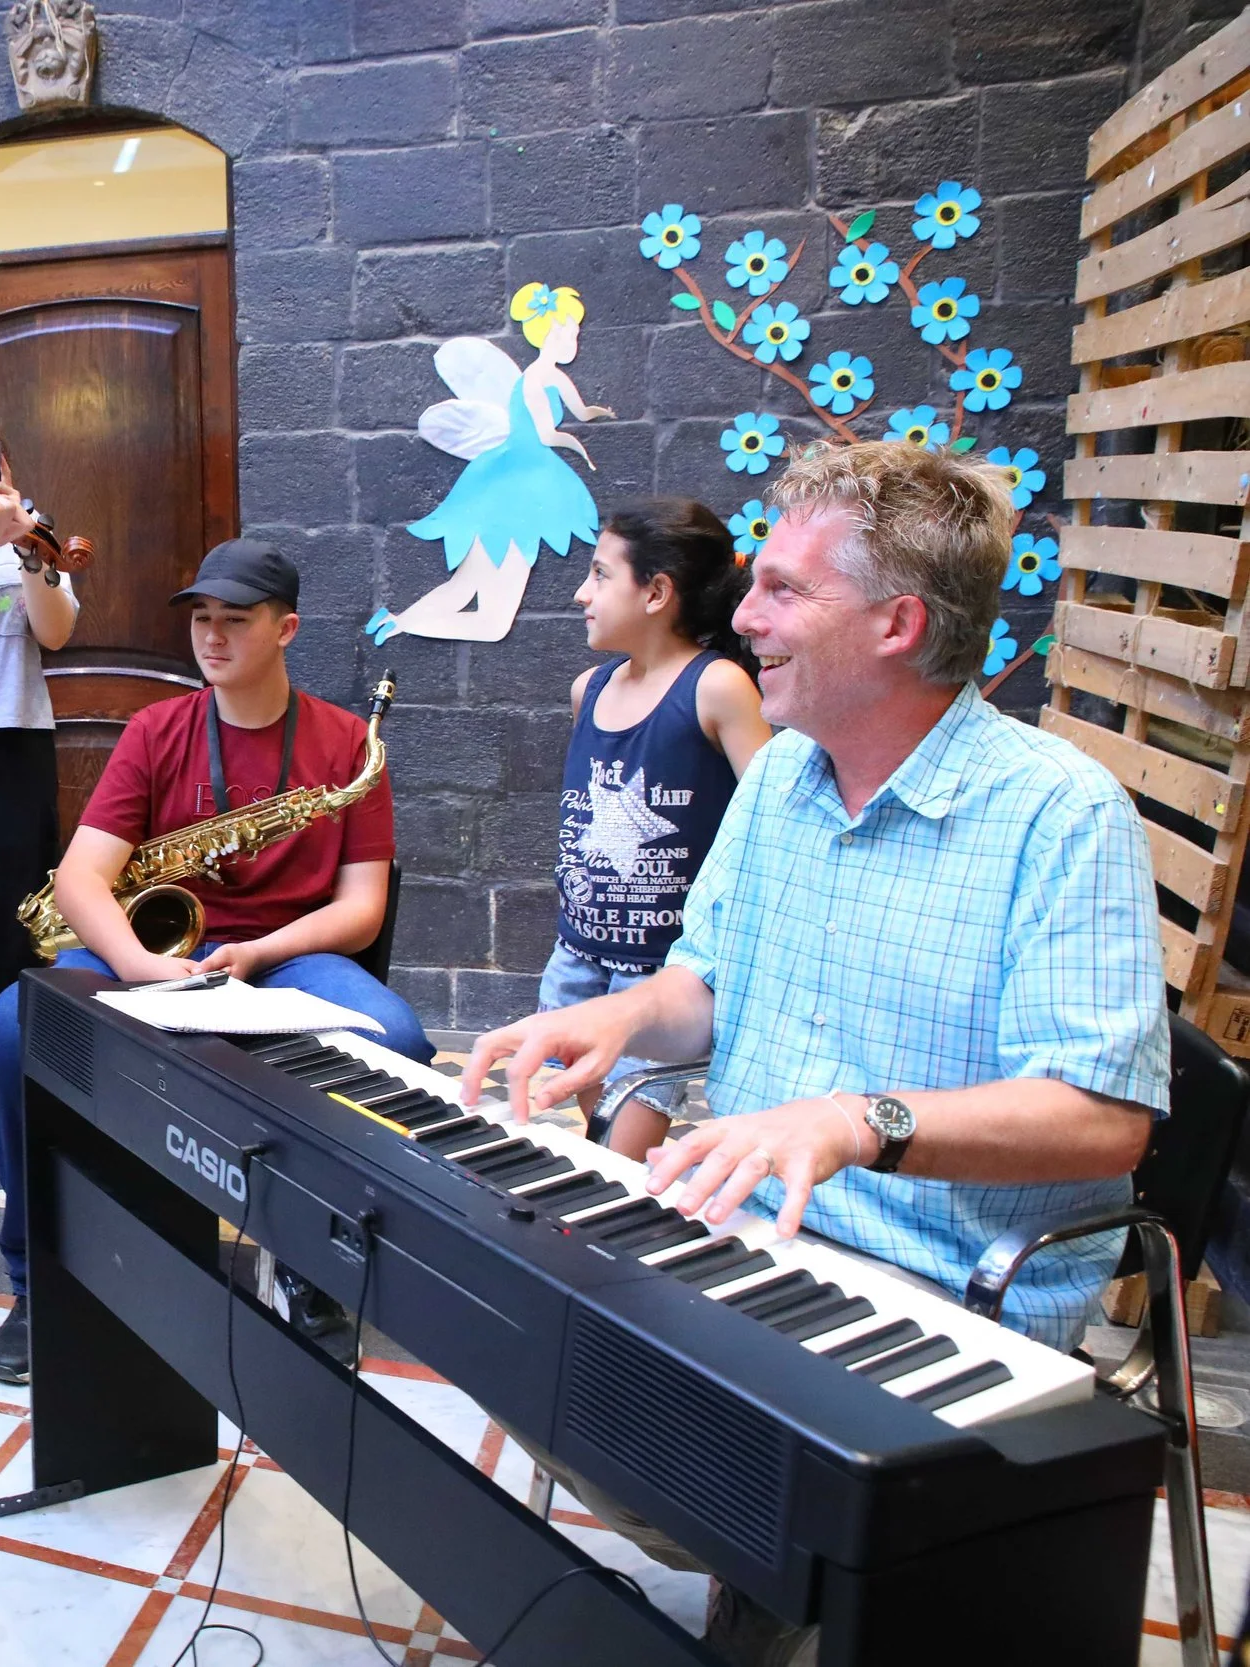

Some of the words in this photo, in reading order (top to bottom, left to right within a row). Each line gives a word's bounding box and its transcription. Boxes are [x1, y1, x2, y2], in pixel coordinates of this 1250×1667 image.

[194, 782, 300, 816] BOS
[631, 860, 674, 877] OUL
[606, 884, 628, 893] AND
[649, 876, 687, 885] NATURE
[596, 893, 606, 902] IS
[606, 893, 626, 903] THE
[627, 894, 658, 904] HEART
[568, 902, 620, 925] STYLE
[165, 1124, 247, 1202] CASIO
